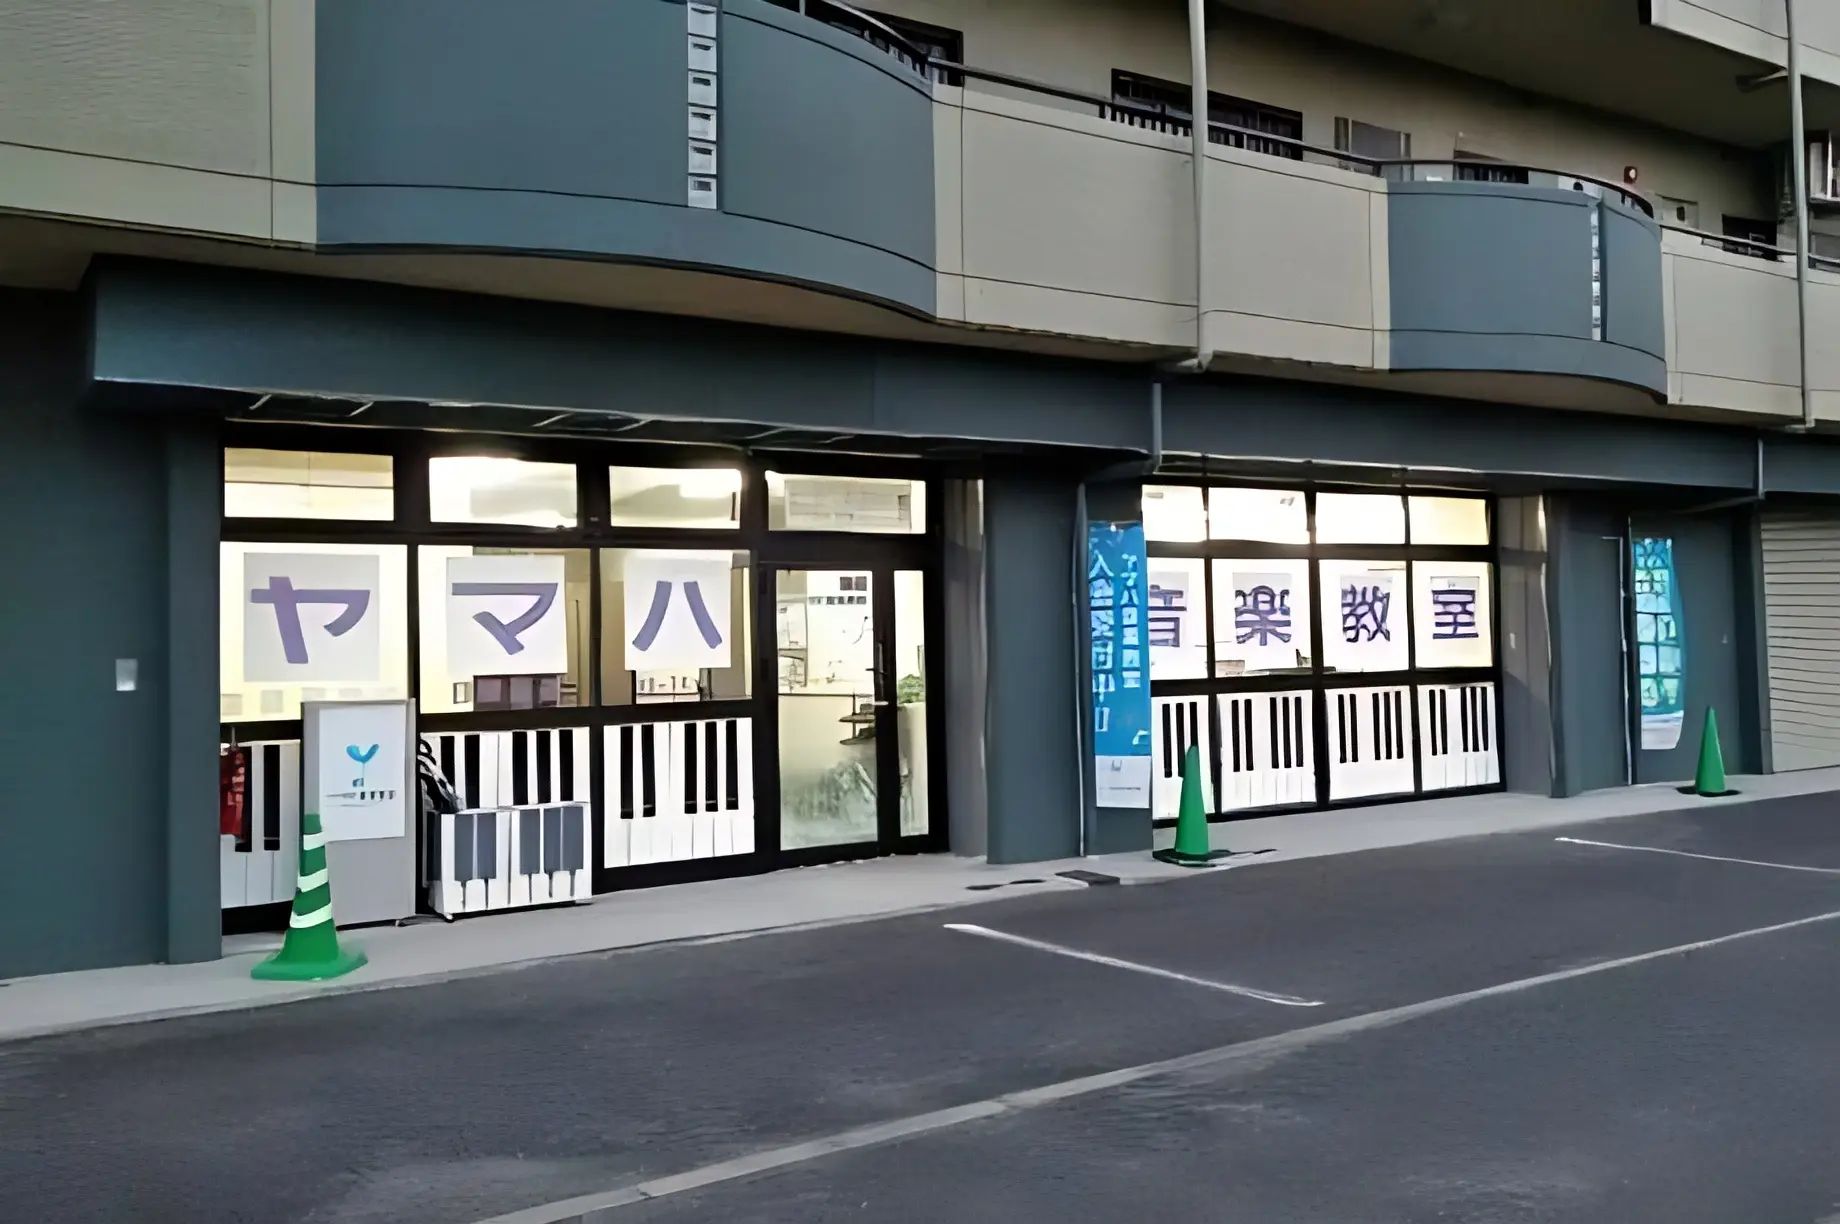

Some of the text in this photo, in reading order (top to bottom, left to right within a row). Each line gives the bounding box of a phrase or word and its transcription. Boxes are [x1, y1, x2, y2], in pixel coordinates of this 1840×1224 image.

[250, 576, 723, 664] ヤマハ
[1149, 585, 1479, 647] 音楽教室
